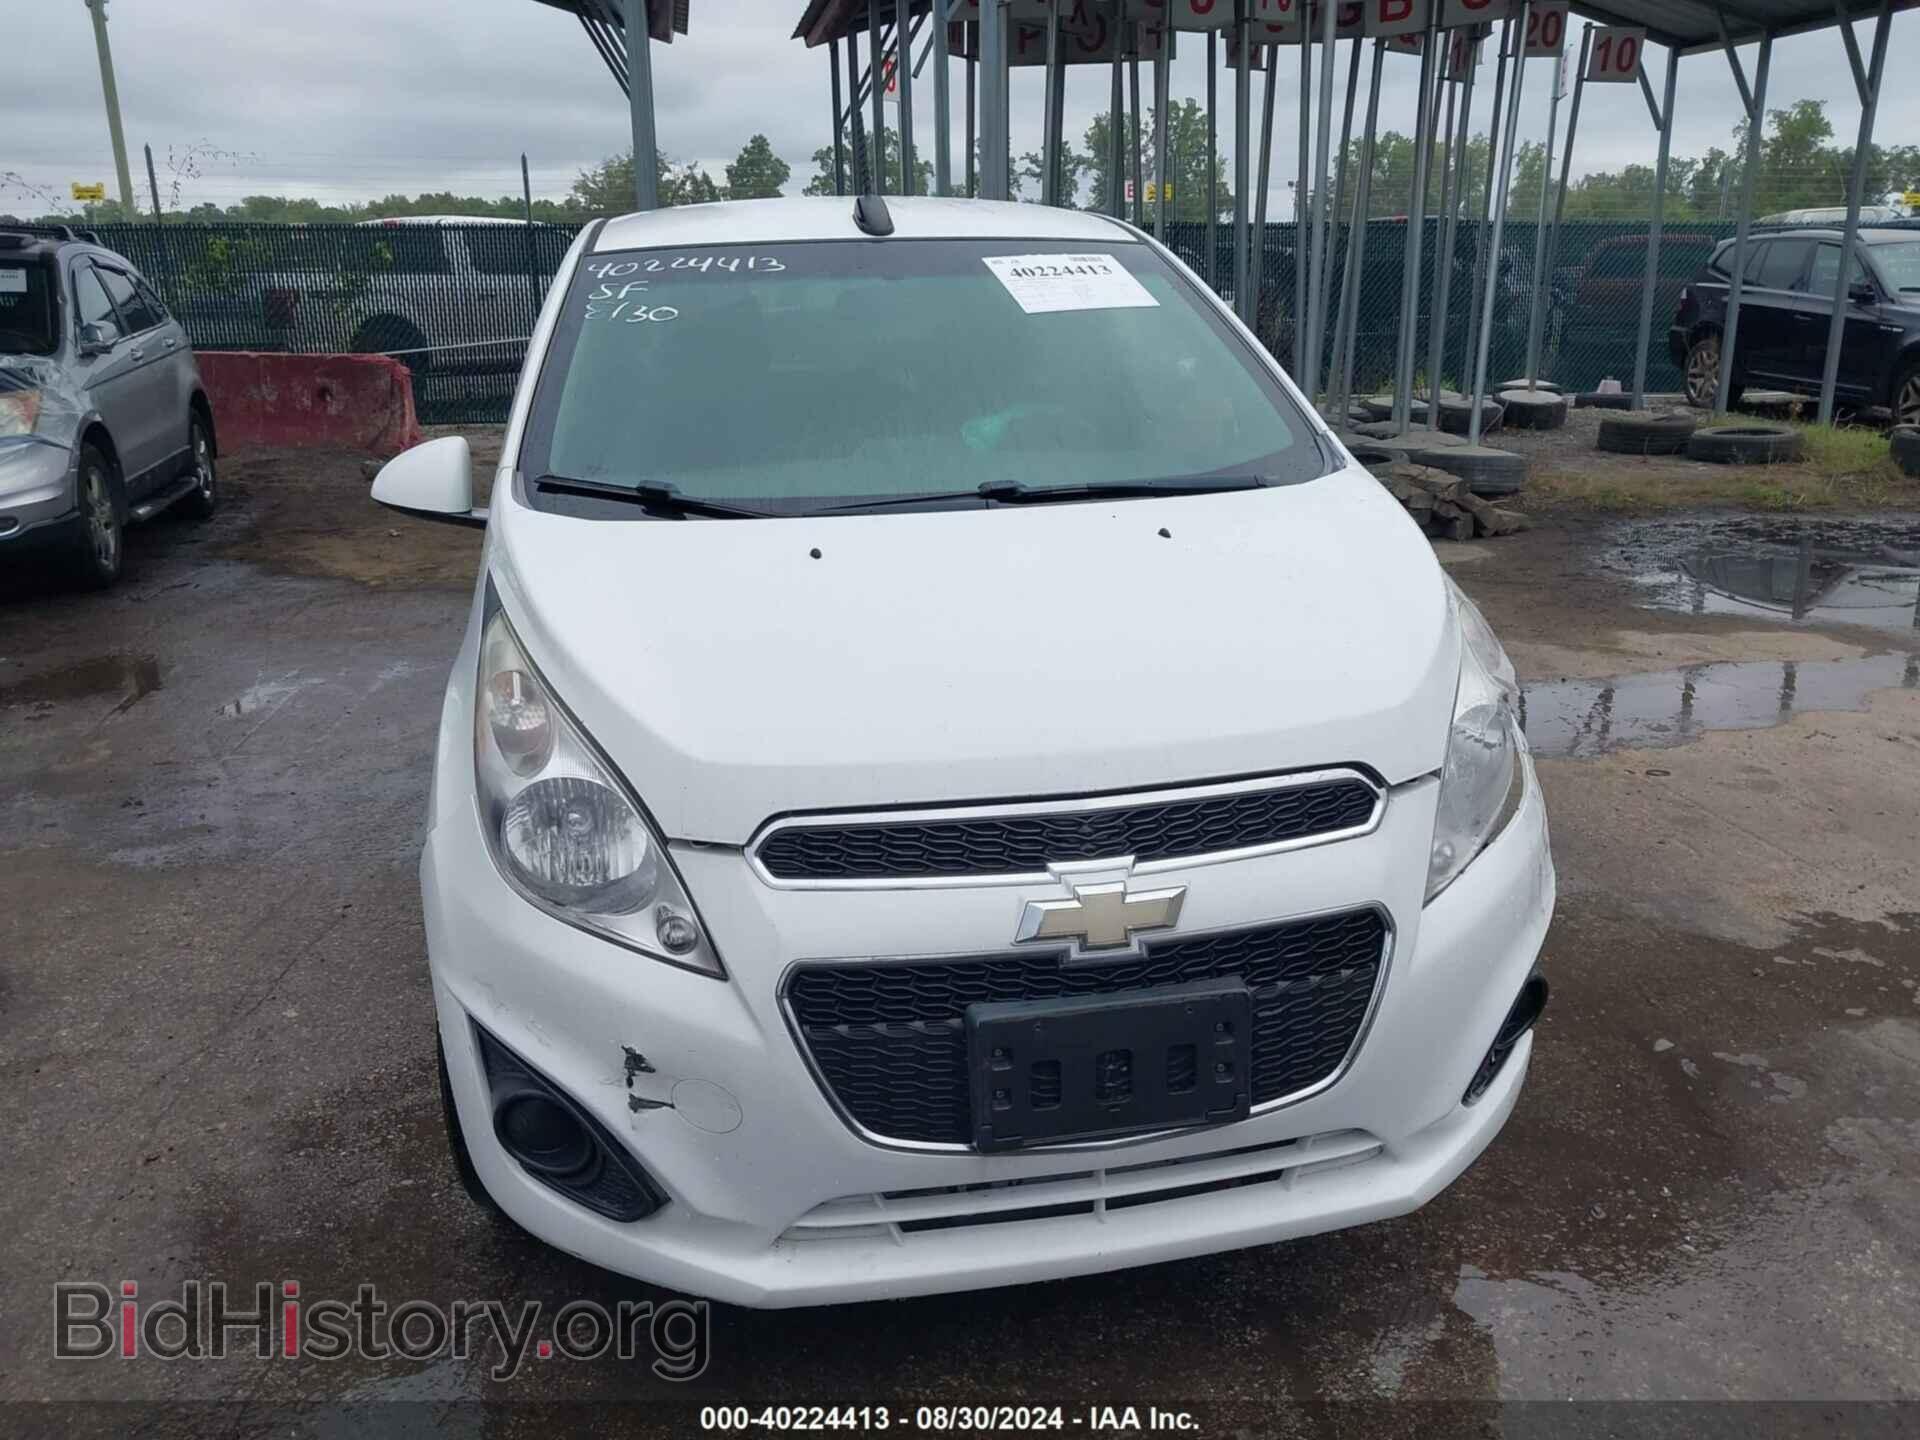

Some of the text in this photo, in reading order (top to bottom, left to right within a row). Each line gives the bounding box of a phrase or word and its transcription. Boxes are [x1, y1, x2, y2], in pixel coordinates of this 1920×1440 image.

[1597, 35, 1638, 73] 10
[588, 256, 786, 279] 40224413
[1010, 264, 1113, 279] 40224413
